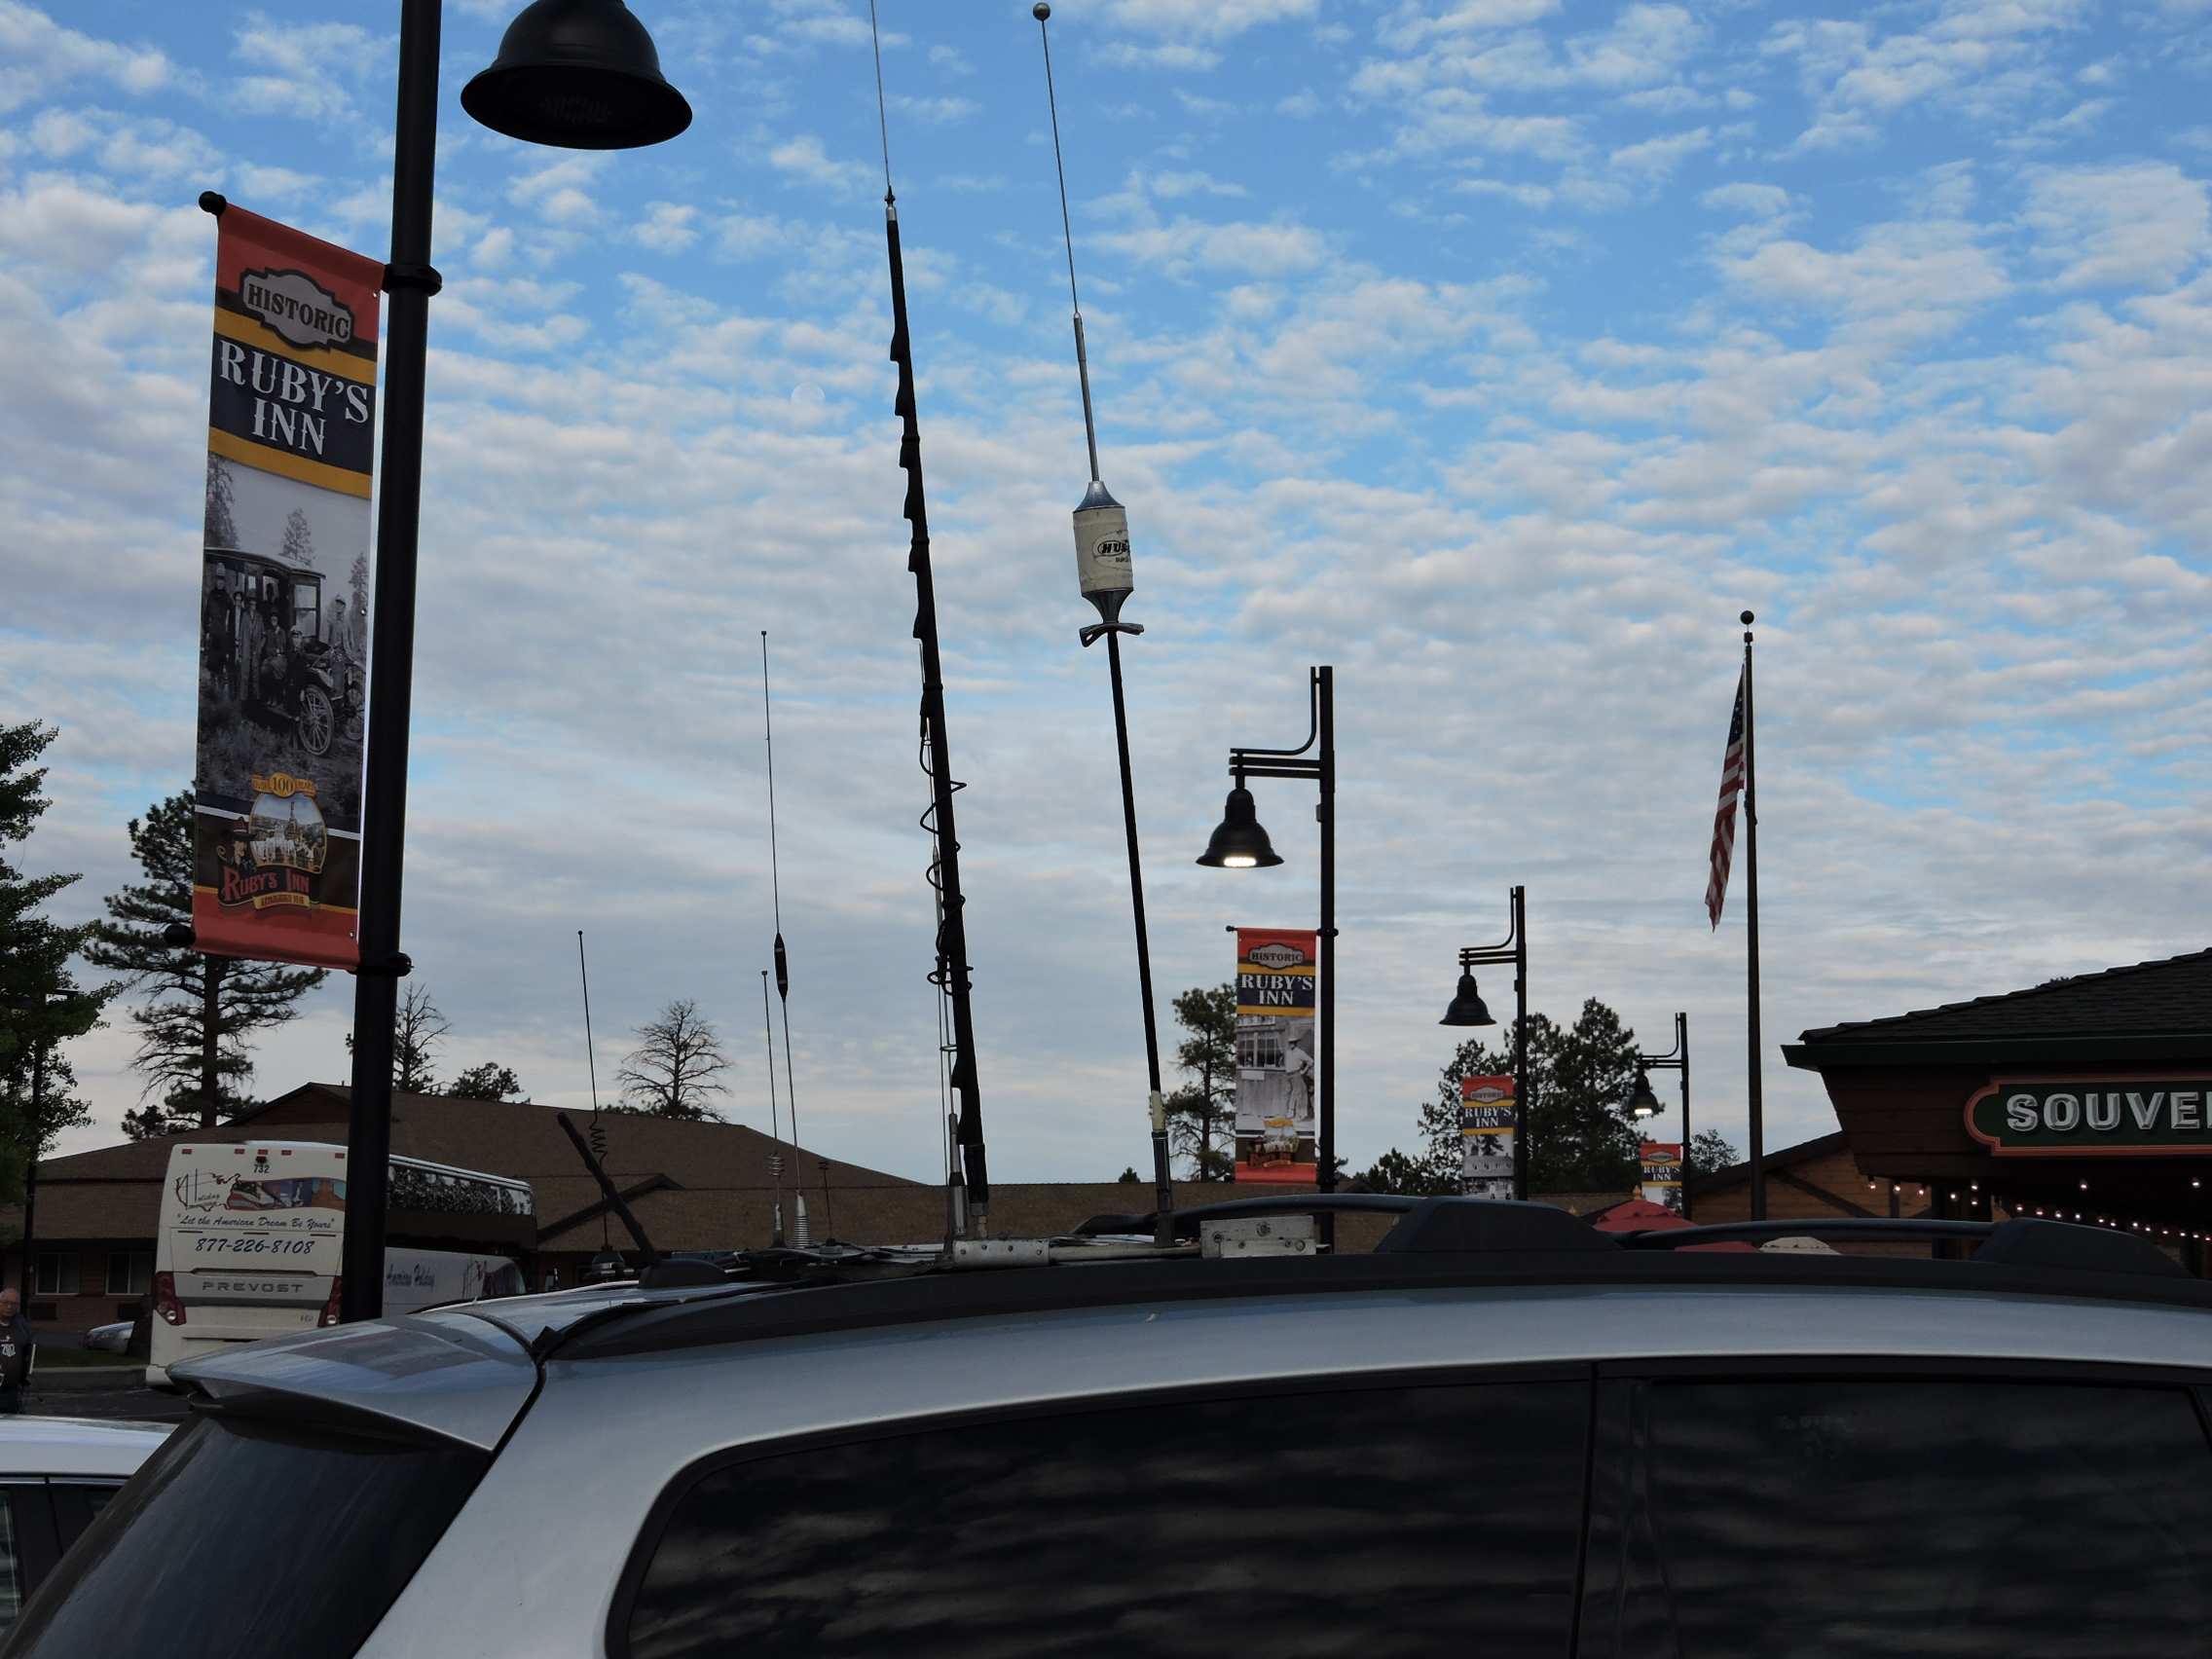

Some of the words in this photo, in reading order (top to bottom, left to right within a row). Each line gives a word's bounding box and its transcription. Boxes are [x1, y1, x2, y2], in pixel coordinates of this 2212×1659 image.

[247, 282, 350, 339] HISTORIC
[219, 339, 369, 424] RUBY'S
[251, 396, 327, 456] INN
[272, 777, 294, 793] 100
[1251, 951, 1303, 962] HISTORIC
[1240, 974, 1314, 991] RUBY'S
[1259, 989, 1294, 1006] INN
[1464, 1106, 1512, 1119] RUBY'S
[1476, 1117, 1499, 1127] INN
[253, 1164, 270, 1174] 732
[198, 1215, 210, 1225] the
[213, 1216, 255, 1227] American
[258, 1216, 288, 1228] Dream
[291, 1218, 304, 1229] Be
[195, 1237, 315, 1255] 877-226-8108
[202, 1281, 304, 1293] PREVOST
